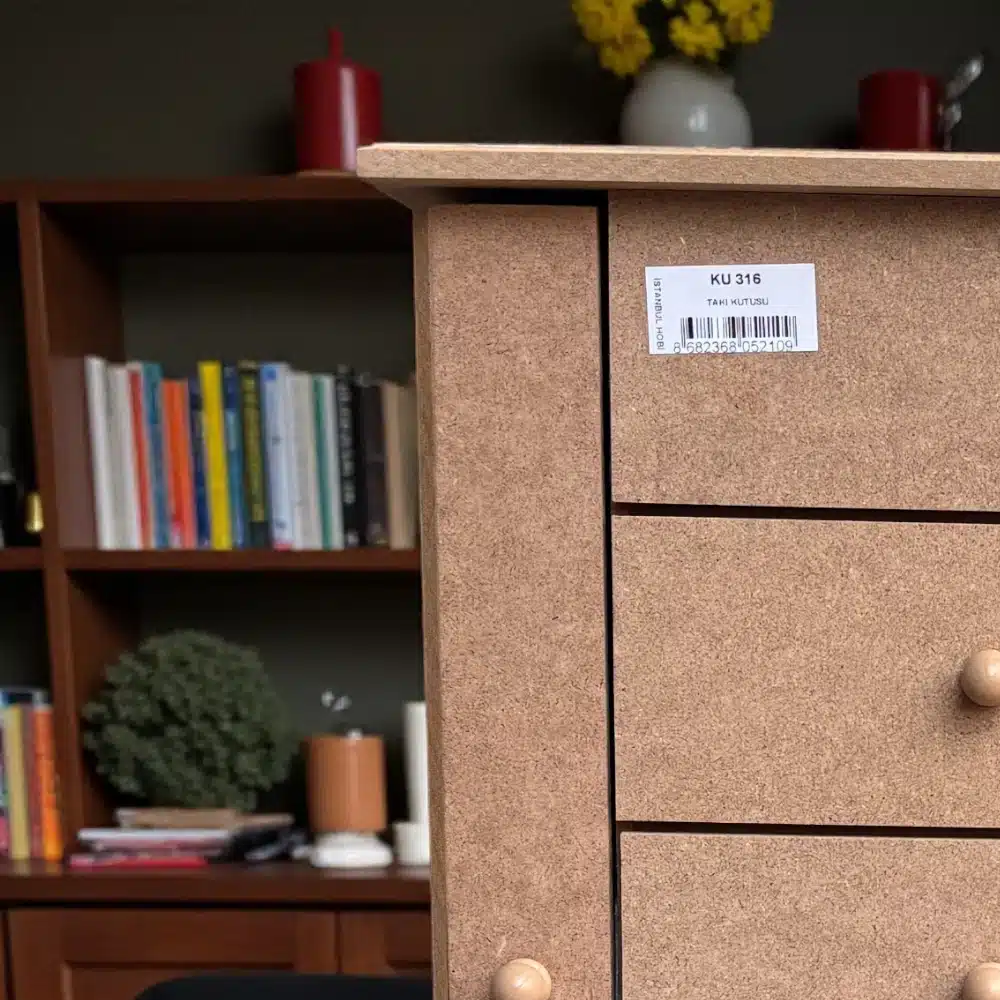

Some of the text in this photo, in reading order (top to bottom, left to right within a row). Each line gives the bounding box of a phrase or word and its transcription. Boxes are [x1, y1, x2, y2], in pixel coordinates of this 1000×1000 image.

[710, 273, 761, 285] KU 316
[731, 297, 769, 306] KUTUSU
[673, 340, 793, 353] 8 682368 052109
